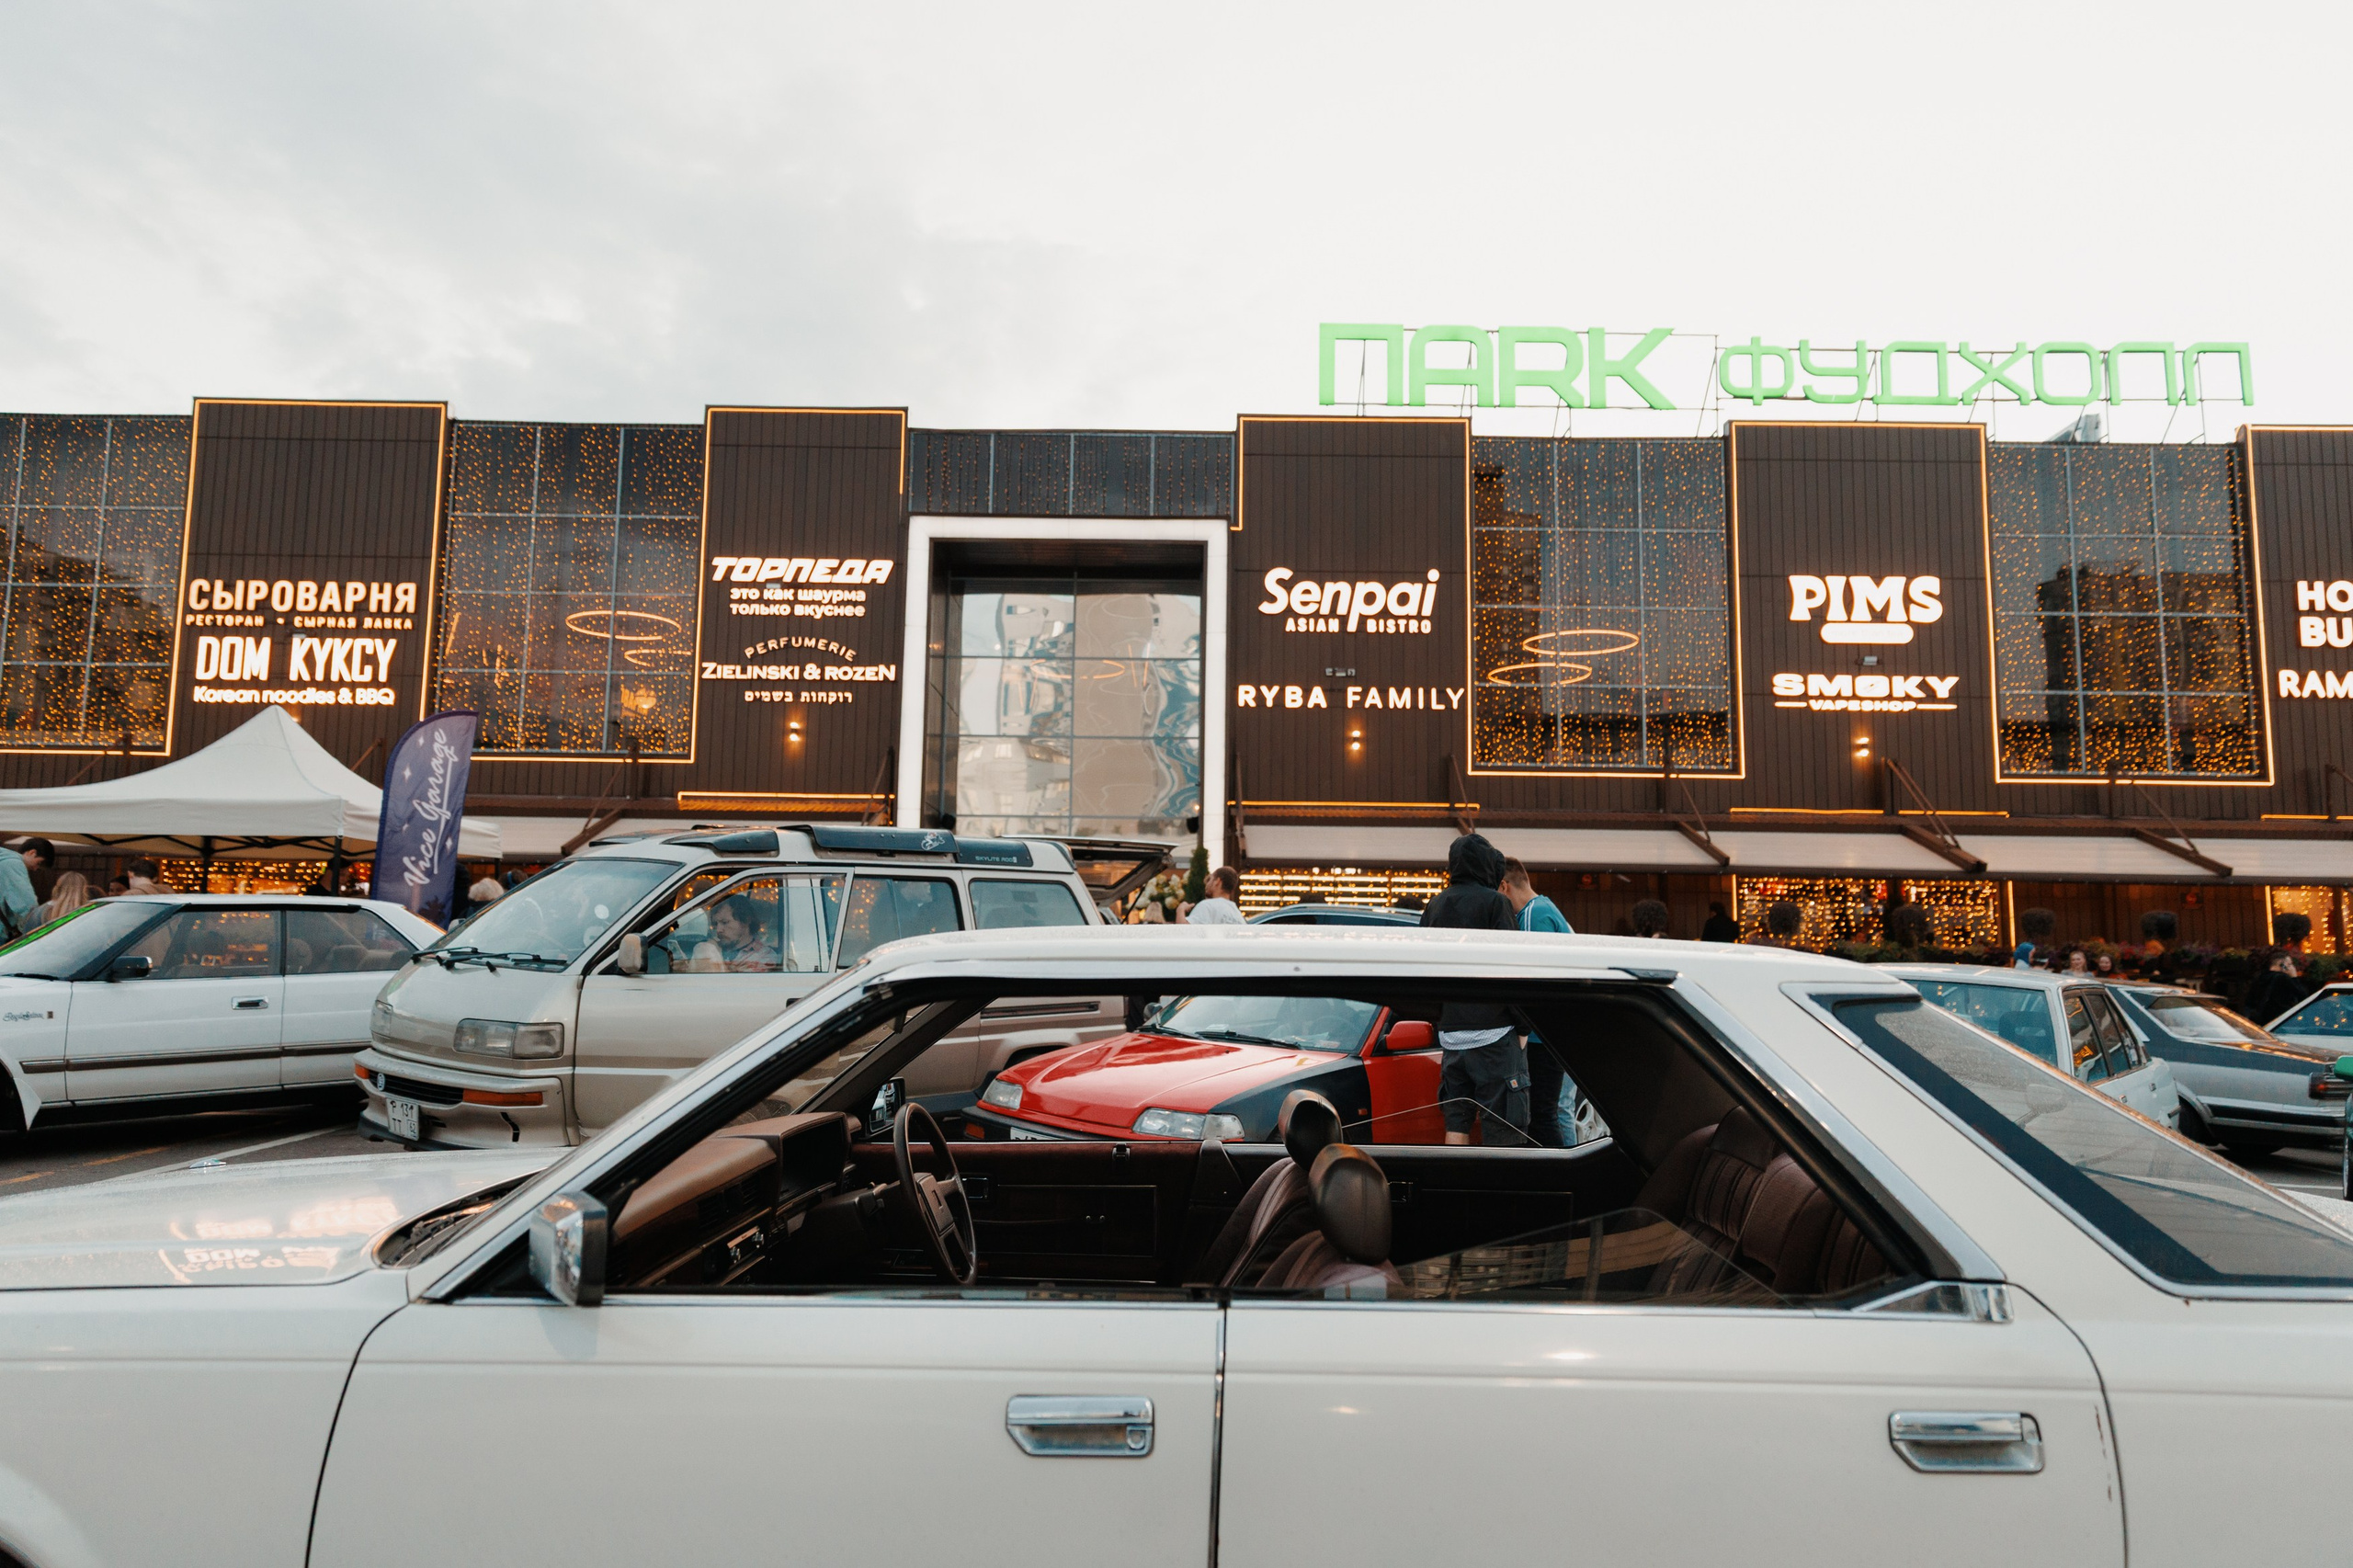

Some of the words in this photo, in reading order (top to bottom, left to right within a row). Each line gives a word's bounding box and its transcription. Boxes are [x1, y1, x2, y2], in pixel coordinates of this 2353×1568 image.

[1719, 336, 2254, 405] ФУДХОЛЛ
[711, 557, 894, 584] ТОРПЕДА
[188, 578, 417, 614] СЫРОВАРНЯ
[730, 588, 760, 600] это
[763, 589, 794, 601] как
[797, 589, 866, 604] шаурма
[1258, 567, 1440, 632] Senpai
[1789, 574, 1943, 623] PIMS
[2297, 580, 2353, 612] HO
[185, 614, 265, 627] РЕСТОРАН
[293, 616, 357, 629] СЫРНАЯ
[362, 617, 413, 630] ЛАВКА
[730, 603, 791, 616] только
[794, 604, 866, 619] вкуснее
[1285, 618, 1339, 632] ASIAN
[1367, 619, 1431, 634] BISTRO
[2299, 616, 2353, 648] BU
[195, 635, 271, 681] DOM
[744, 636, 858, 662] PERFUMERIE
[803, 663, 821, 681] &
[2278, 669, 2353, 699] RAM
[193, 686, 260, 704] Korean
[262, 687, 336, 705] noodles
[336, 687, 354, 704] &
[356, 687, 395, 706] BBQ
[1237, 685, 1327, 709] RYBA
[1347, 687, 1465, 710] FAMILY
[1808, 699, 1917, 712] VAPESHOP
[412, 727, 459, 821] Garage
[403, 828, 437, 887] Vice
